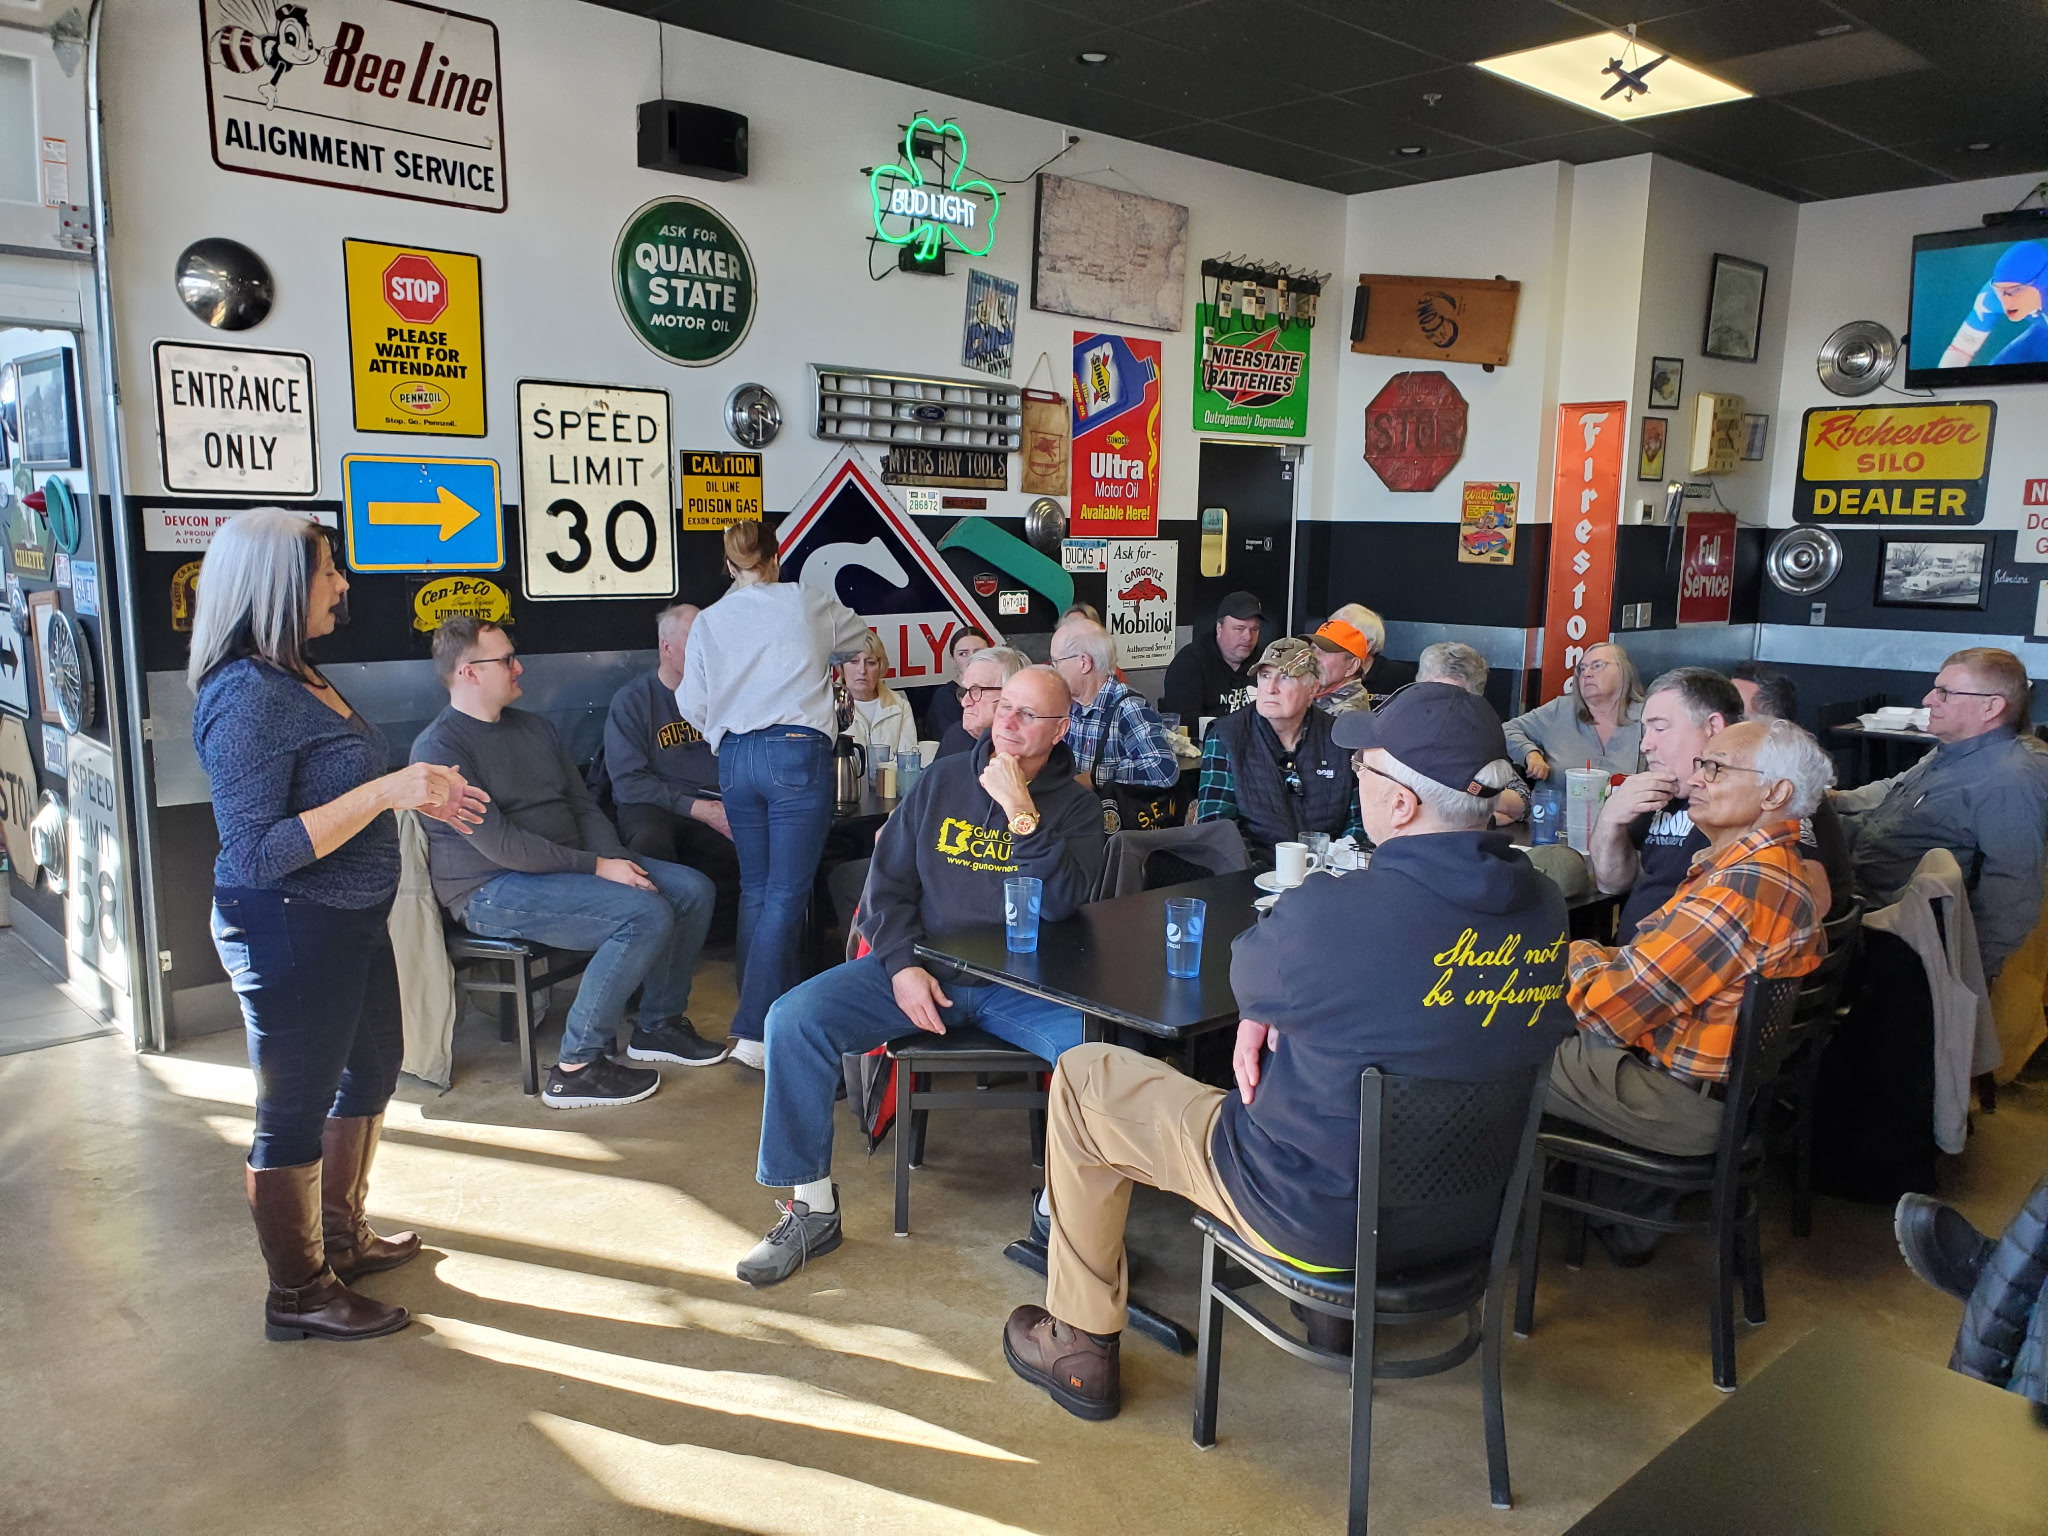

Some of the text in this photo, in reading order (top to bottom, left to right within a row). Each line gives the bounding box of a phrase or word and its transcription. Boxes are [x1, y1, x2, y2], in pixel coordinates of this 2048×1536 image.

[323, 21, 493, 116] Bee Line
[225, 117, 496, 193] ALIGNMENT SERVICE
[892, 188, 978, 229] BUD LIGHT
[659, 225, 718, 243] ASK FOR
[635, 242, 743, 282] QUAKER
[391, 276, 441, 304] STOP
[648, 276, 738, 314] STATE
[650, 313, 731, 333] MOTOR OIL
[386, 327, 448, 347] PLEASE
[375, 342, 460, 364] WAIT FOR
[1209, 346, 1301, 373] NTERSTATE
[368, 358, 468, 380] ATTENDANT
[1091, 353, 1111, 404] SUNOCO
[1208, 368, 1294, 393] BATTERIES
[171, 369, 303, 414] ENTRANCE
[399, 392, 442, 404] PENNZOIL
[385, 416, 406, 426] Stop.
[423, 418, 458, 428] Pennzoil.
[919, 406, 940, 419] Ford
[1204, 409, 1295, 431] Outrageously Dependable
[533, 408, 658, 444] SPEED
[1813, 414, 1982, 452] Rochester
[204, 431, 278, 471] ONLY
[1106, 435, 1129, 446] SUNOCO
[549, 453, 645, 487] LIMIT
[691, 455, 756, 475] CAUTION
[889, 447, 1007, 479] MYERS HAY TOOLS
[1090, 451, 1144, 480] Ultra
[1856, 451, 1926, 473] SILO
[705, 481, 741, 493] OIL LINE
[1094, 480, 1140, 499] Motor Oil
[688, 498, 759, 514] POISON GAS
[1080, 503, 1151, 521] Available Here!
[1812, 488, 1968, 517] DEALER
[164, 515, 210, 527] DEVCON
[688, 517, 710, 526] EXXON
[546, 497, 657, 575] 30
[14, 548, 47, 571] GILLETTE
[1065, 548, 1094, 564] DUCKS
[1113, 544, 1134, 560] Ask
[1698, 534, 1722, 566] Full
[1124, 566, 1164, 584] GARGOYLE
[1684, 566, 1730, 599] Service
[422, 581, 491, 607] Cen-Pe-Co
[434, 608, 492, 620] LUBRICANTS
[1110, 611, 1173, 636] Mobiloil
[1126, 644, 1154, 654] Authorized
[71, 760, 114, 813] SPEED
[77, 807, 111, 859] LIMIT
[973, 826, 1000, 840] GUN
[970, 840, 1011, 862] CAU
[946, 856, 1019, 873] www.gunowners
[76, 854, 119, 954] 58
[1433, 928, 1568, 967] Shall not
[1422, 965, 1568, 1028] be infringed
